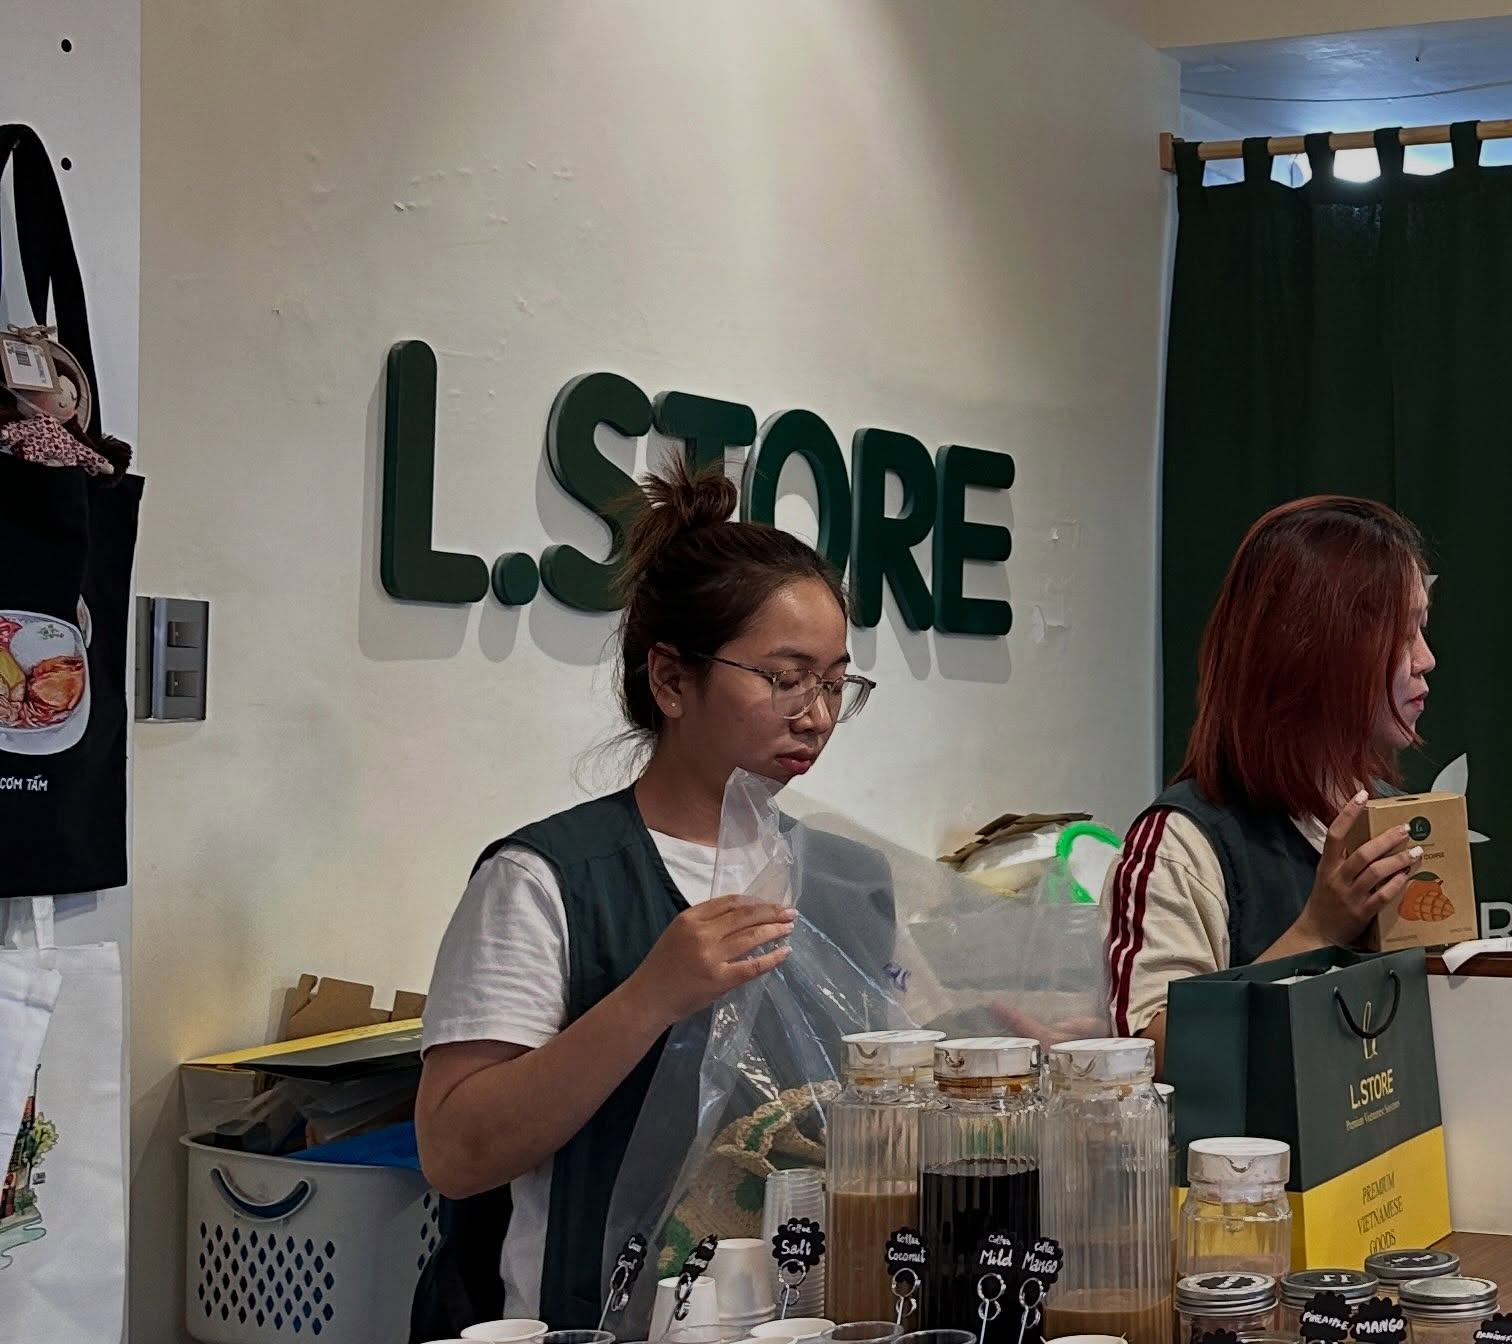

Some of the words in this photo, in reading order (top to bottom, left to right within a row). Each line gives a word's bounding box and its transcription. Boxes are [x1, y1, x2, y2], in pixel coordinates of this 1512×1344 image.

[1350, 1068, 1394, 1109] L.STORE
[1362, 1170, 1395, 1205] PREMIUM
[1357, 1195, 1404, 1235] VIETNAMESE
[780, 1238, 812, 1256] Salt
[1369, 1229, 1397, 1255] GOODS
[888, 1246, 927, 1264] Coconut
[979, 1248, 1013, 1268] Mild
[1355, 1317, 1404, 1335] MANGO
